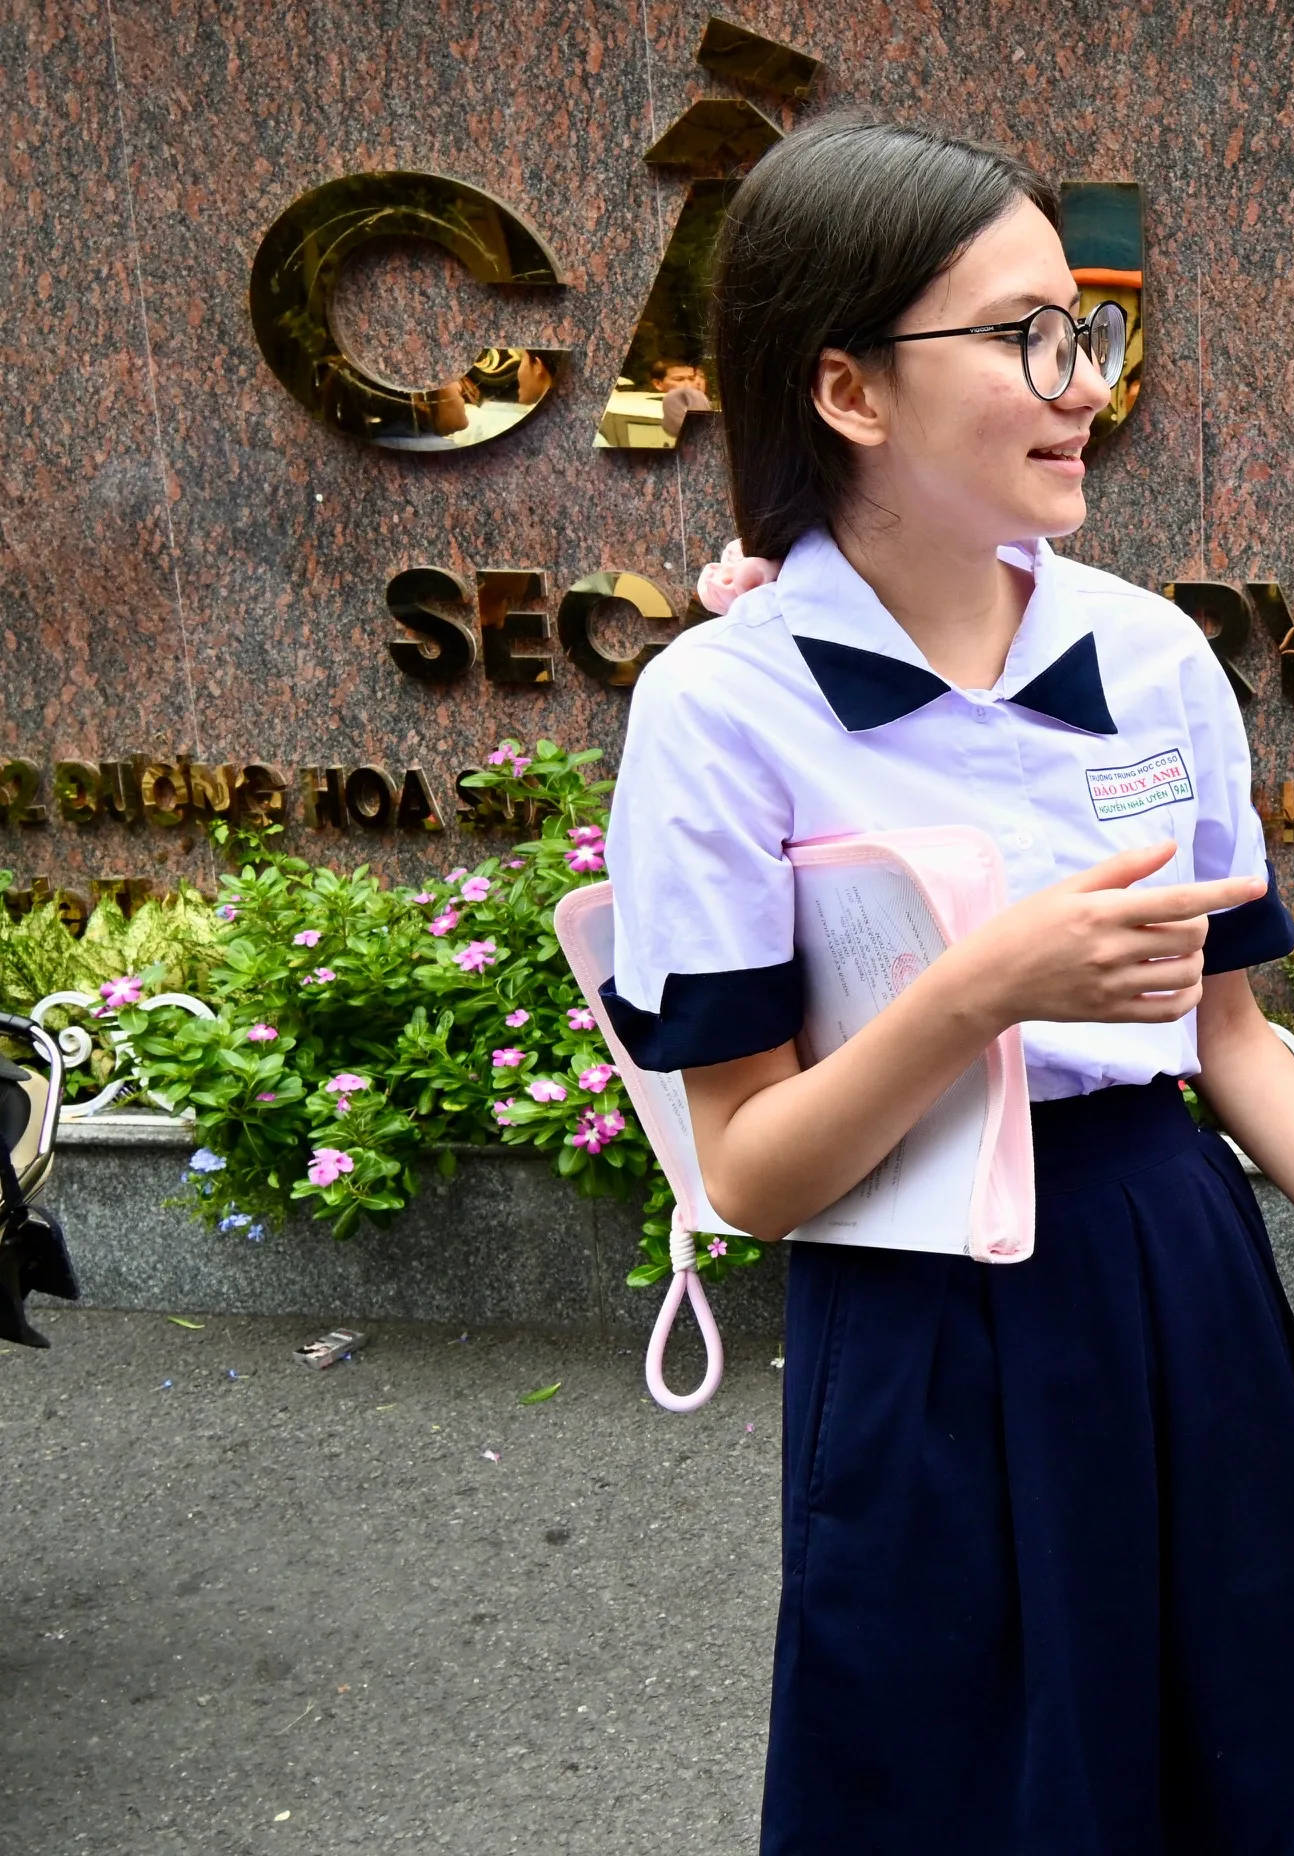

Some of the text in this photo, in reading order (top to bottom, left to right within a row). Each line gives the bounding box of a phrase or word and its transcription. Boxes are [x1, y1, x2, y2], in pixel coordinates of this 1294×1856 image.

[1092, 767, 1181, 797] ĐÀO DUY ANH
[1173, 783, 1190, 797] 9A1
[300, 764, 446, 832] HOA
